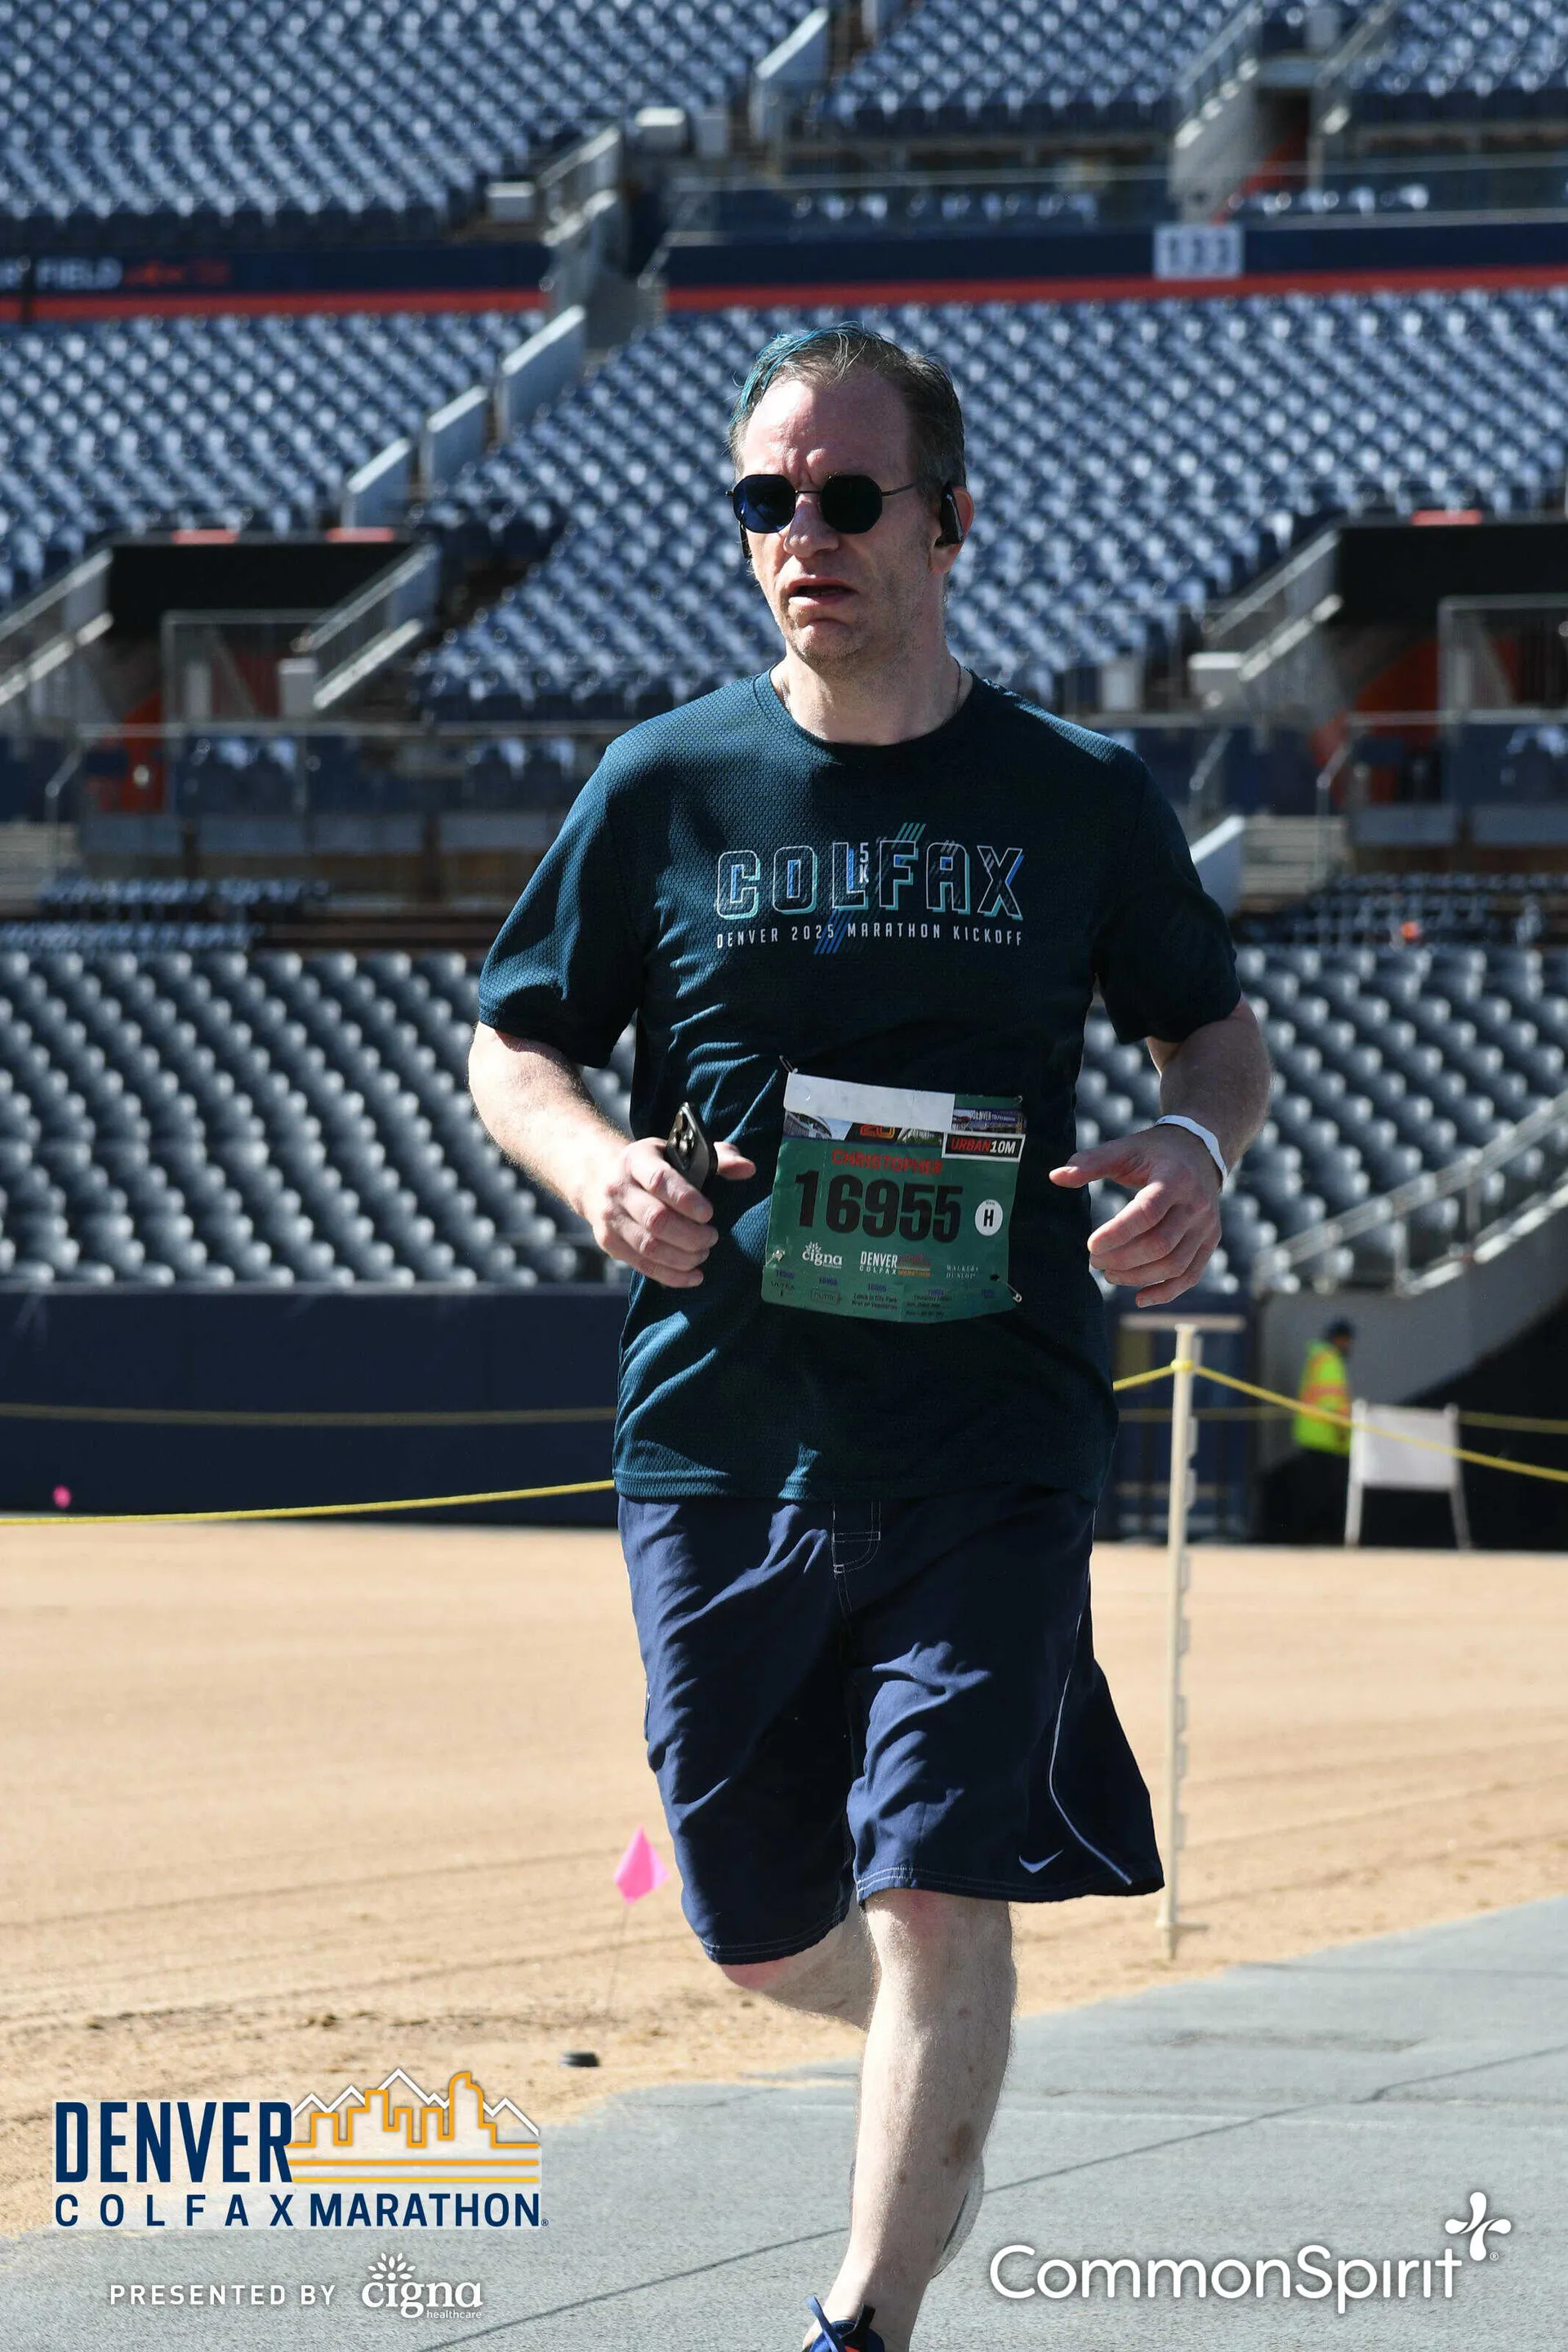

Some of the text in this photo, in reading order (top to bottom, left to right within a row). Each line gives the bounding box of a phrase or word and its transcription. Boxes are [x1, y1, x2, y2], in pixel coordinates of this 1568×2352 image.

[715, 840, 1025, 920] COLFAX
[716, 922, 1024, 949] DENVER 2025 MARATHON KICKOFF
[831, 1149, 944, 1175] CHRISTOPHER
[795, 1169, 963, 1243] 16955
[983, 1209, 994, 1227] H
[802, 1250, 844, 1267] cigna
[860, 1251, 898, 1268] DENVER
[859, 1265, 897, 1276] COLFAX
